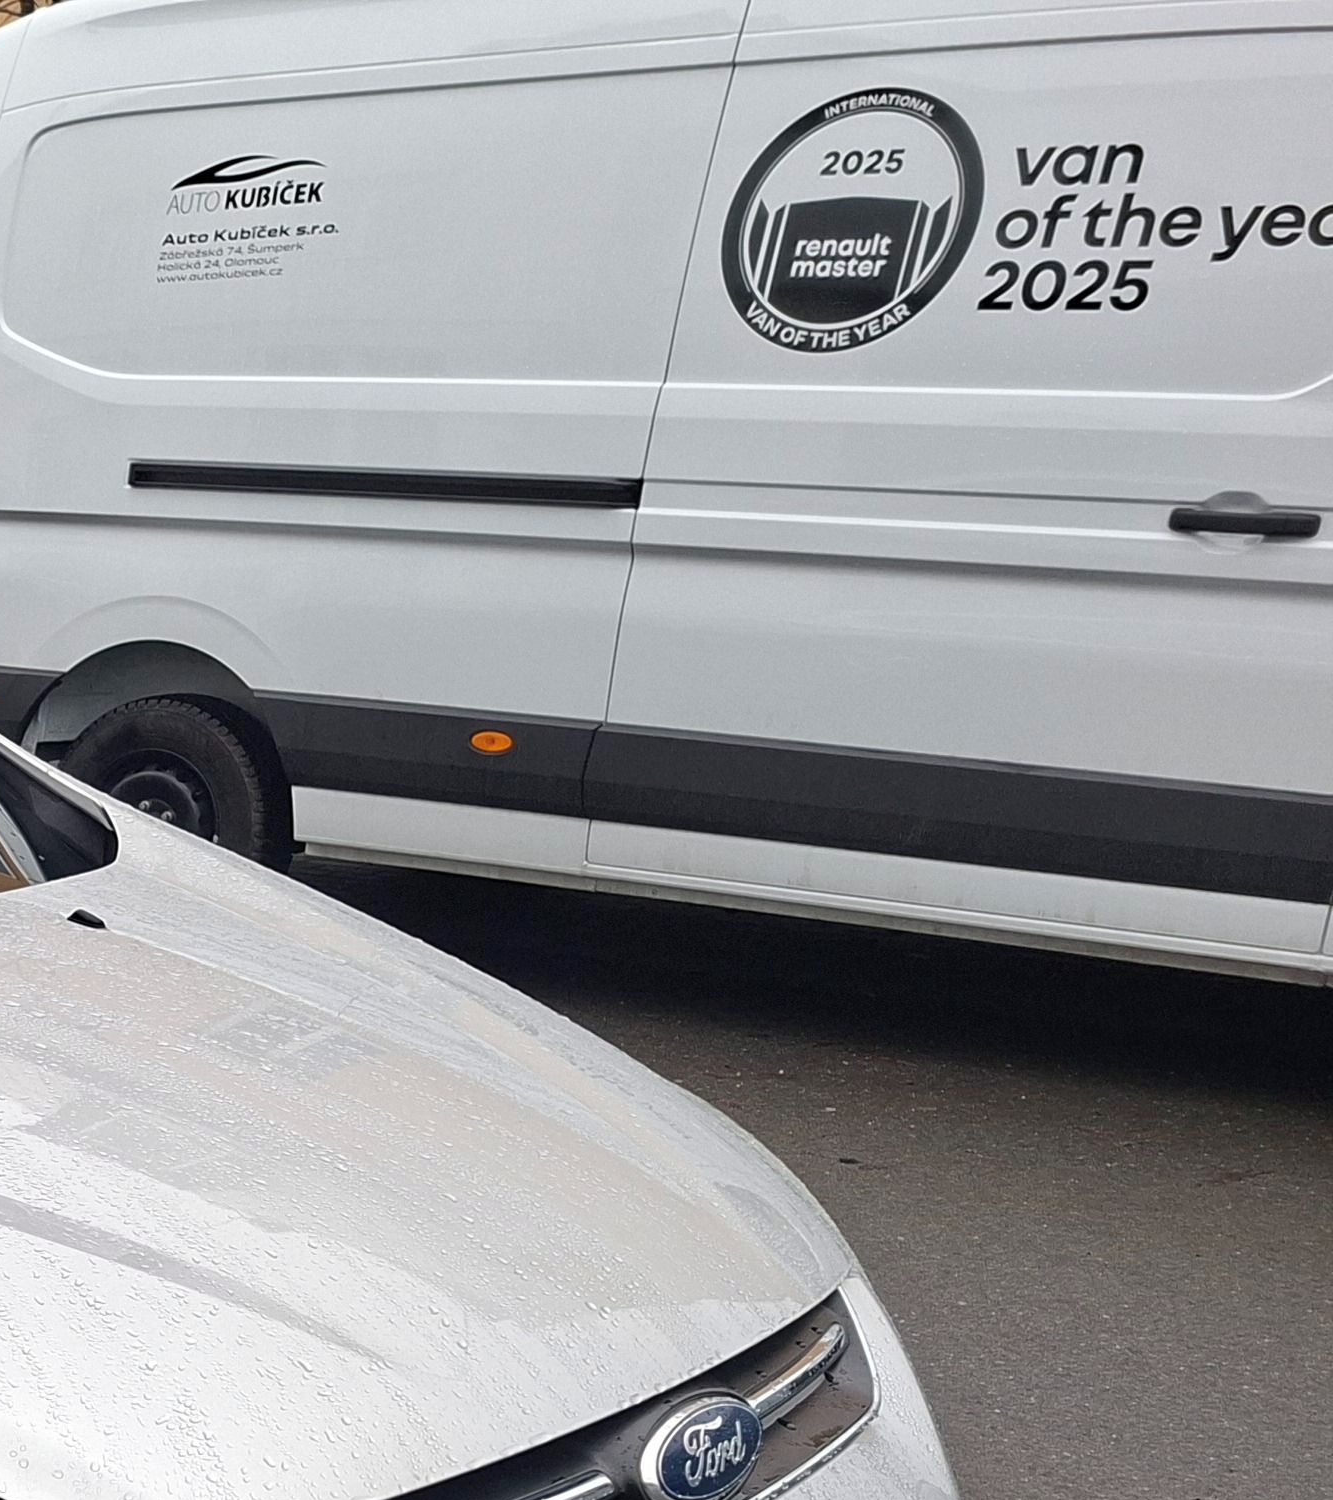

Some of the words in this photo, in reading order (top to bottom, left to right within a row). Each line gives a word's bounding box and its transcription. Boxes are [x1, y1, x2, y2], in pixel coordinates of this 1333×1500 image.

[824, 93, 935, 119] INTERNATIONAL
[819, 149, 905, 176] 2025
[1016, 143, 1145, 187] van
[166, 190, 221, 215] AUTO
[225, 179, 325, 210] KUBÍČEK
[995, 193, 1079, 249] of
[1083, 192, 1203, 248] the
[162, 233, 209, 246] Auto
[214, 224, 290, 242] Kubíček
[296, 223, 340, 237] s.r.o.
[794, 233, 892, 257] renault
[157, 267, 284, 283] www.autokubicek.cz
[224, 256, 280, 267] Olomouc
[790, 258, 887, 278] master
[977, 260, 1154, 312] 2025
[745, 300, 780, 337] VAN
[779, 326, 809, 346] OF
[810, 330, 850, 349] THE
[853, 303, 911, 342] YEAR
[683, 1415, 746, 1488] Ford
